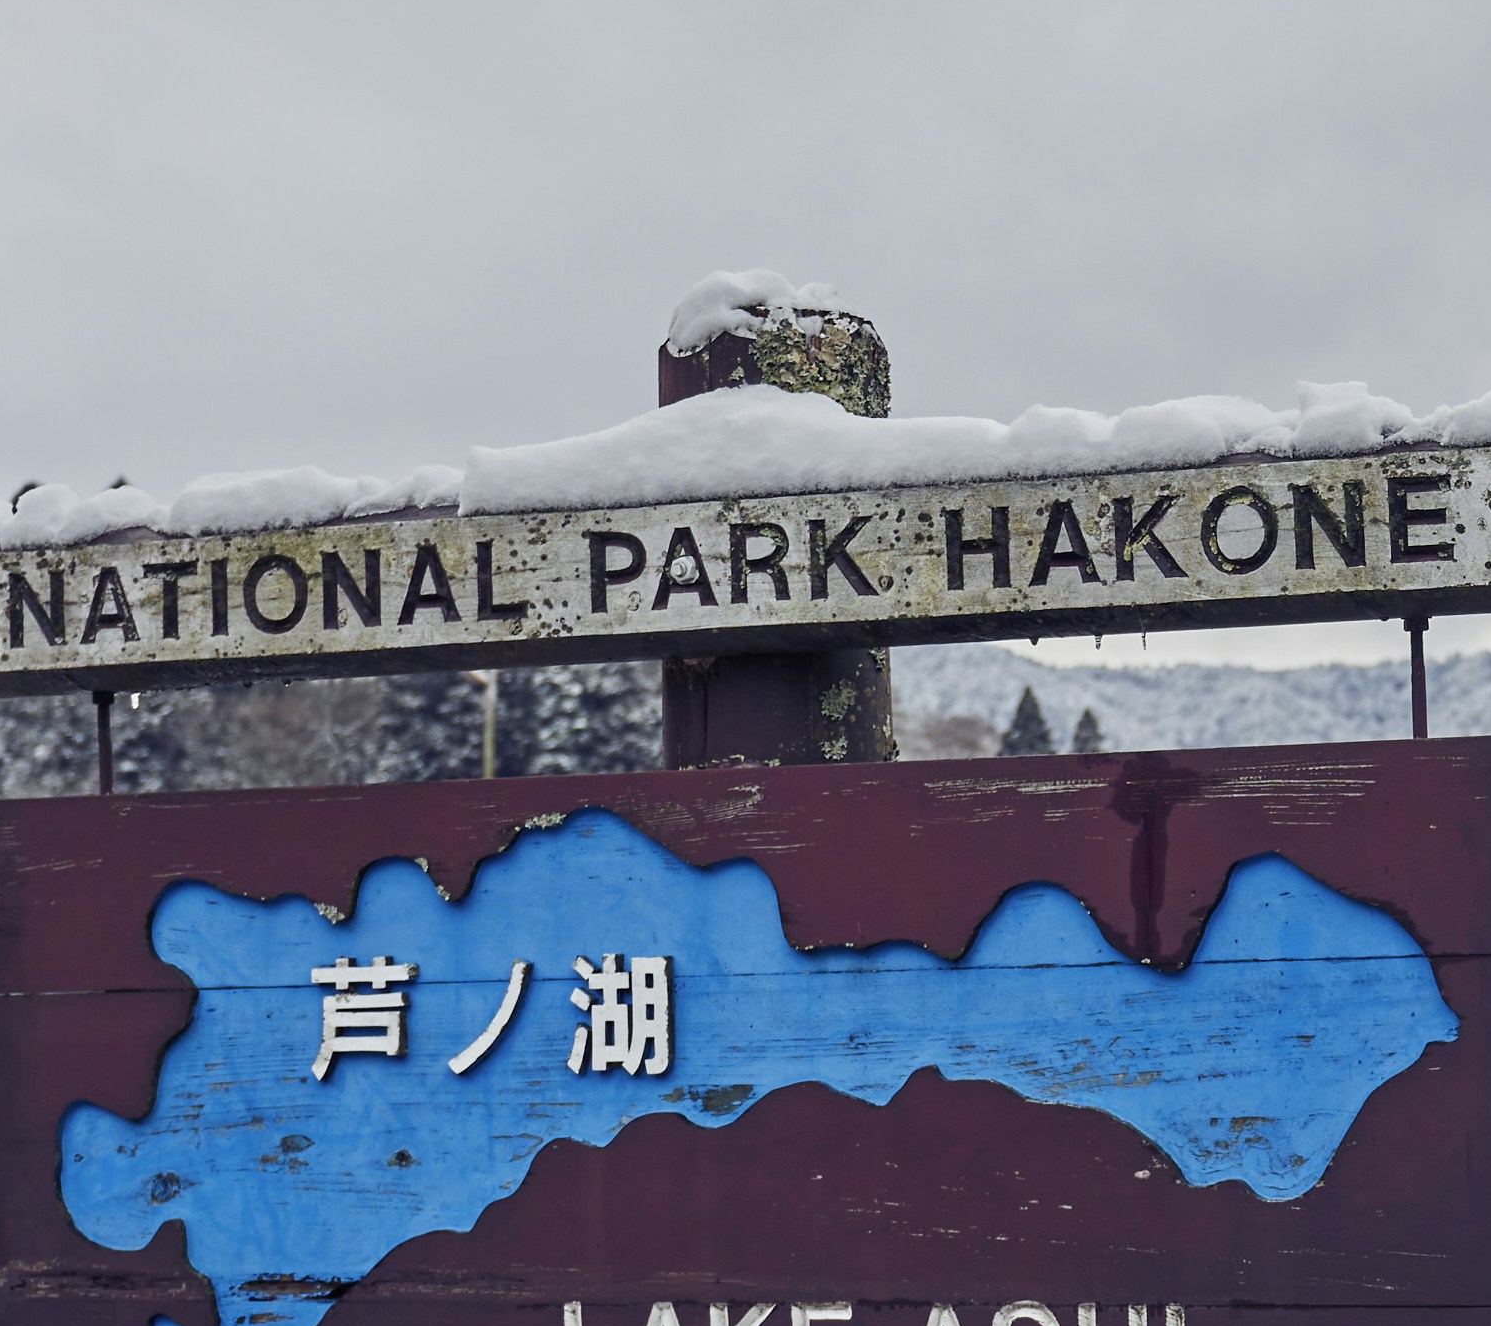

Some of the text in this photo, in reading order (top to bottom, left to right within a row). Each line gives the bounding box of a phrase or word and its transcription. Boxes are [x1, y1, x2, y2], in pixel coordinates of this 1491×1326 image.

[9, 475, 1455, 649] NATIONAL PARK HAKONE
[310, 952, 673, 1081] 芦ノ湖
